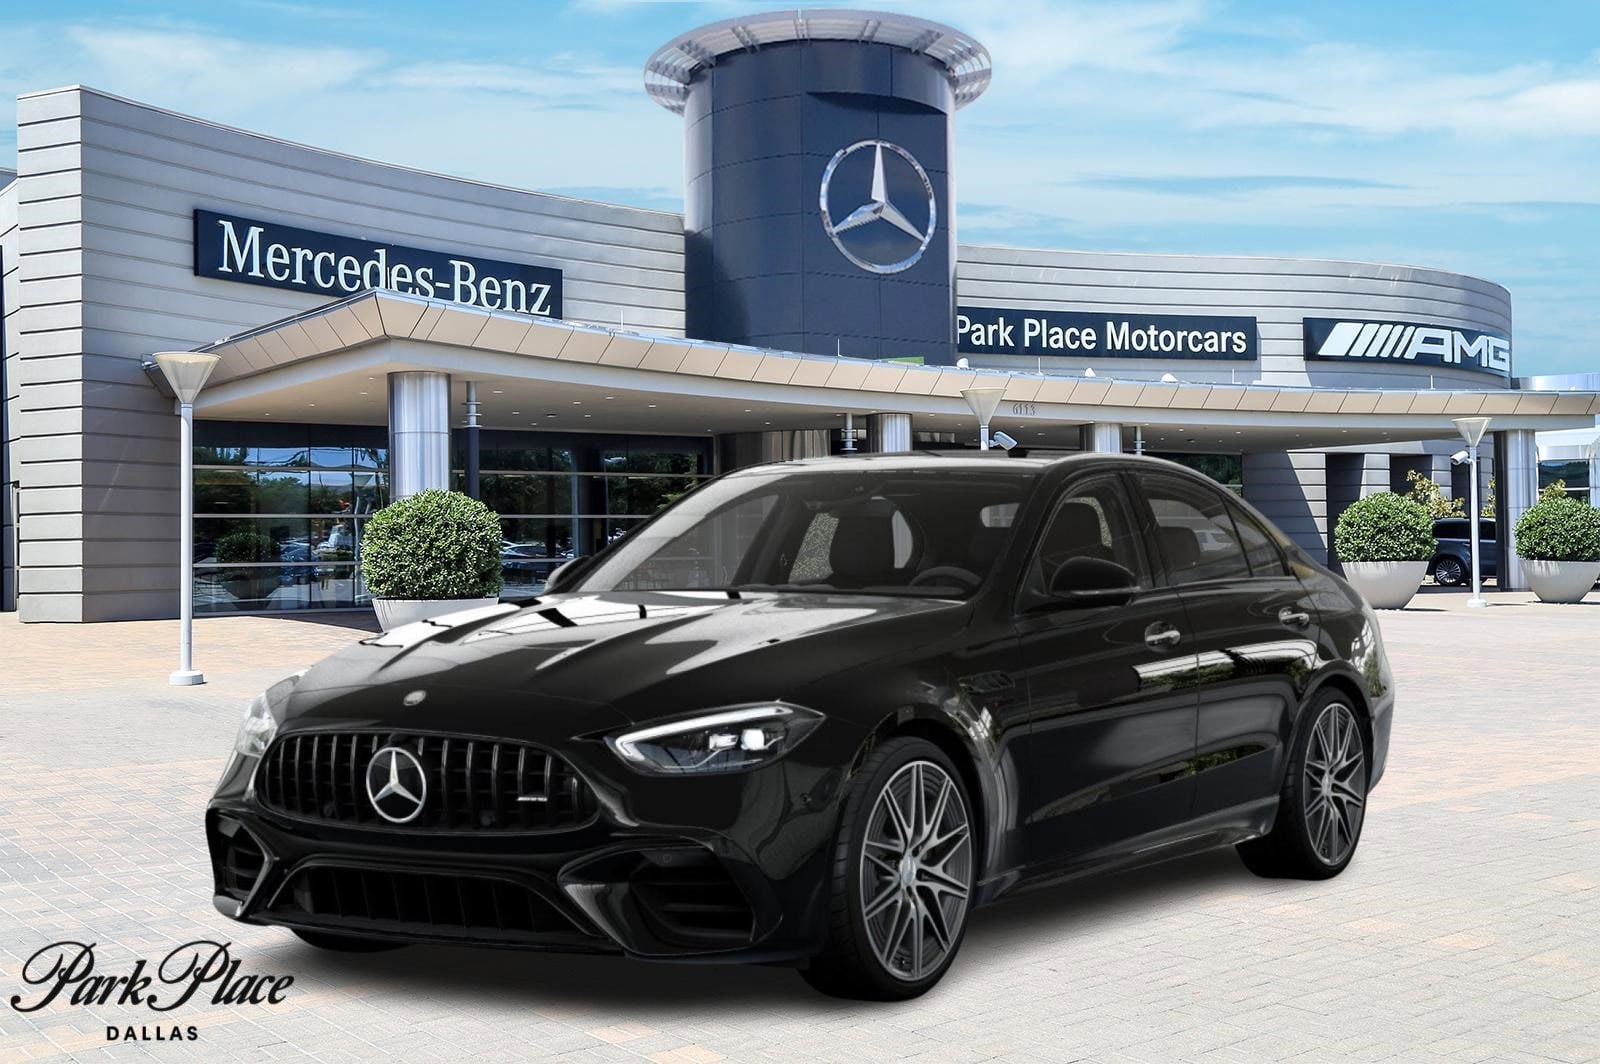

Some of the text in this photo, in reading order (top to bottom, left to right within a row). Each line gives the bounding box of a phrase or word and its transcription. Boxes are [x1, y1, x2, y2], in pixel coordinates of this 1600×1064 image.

[217, 219, 553, 317] Mercedes-Benz
[957, 315, 1248, 354] Park Place Motorcars
[1012, 402, 1036, 416] 6113
